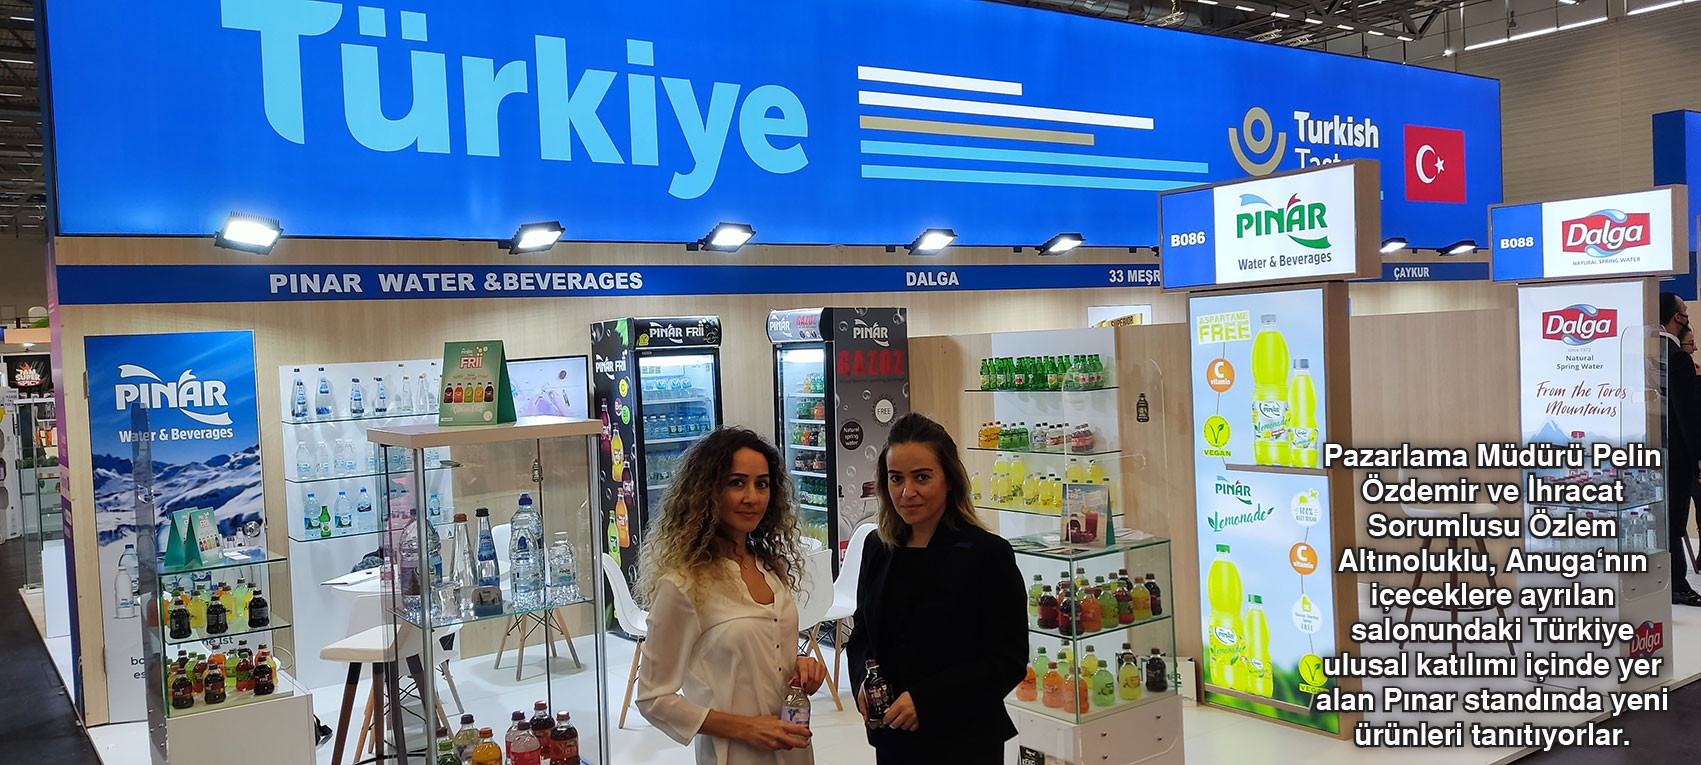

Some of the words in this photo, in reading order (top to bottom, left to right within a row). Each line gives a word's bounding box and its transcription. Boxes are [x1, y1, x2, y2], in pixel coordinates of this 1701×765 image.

[220, 0, 809, 199] Türkiye
[1293, 110, 1380, 149] Turkish
[1236, 200, 1328, 239] PINAR
[1170, 231, 1206, 248] B086
[1500, 236, 1535, 249] B088
[1565, 219, 1644, 250] Dalga
[1238, 256, 1267, 271] Water
[1269, 256, 1277, 268] &
[1279, 250, 1332, 268] Beverages
[905, 271, 960, 287] DALGA
[1109, 269, 1125, 283] 33
[1393, 266, 1430, 281] ÇAYKUR
[269, 273, 364, 294] PINAR
[378, 272, 476, 293] WATER
[483, 271, 644, 291] &BEVERAGES
[1200, 312, 1248, 325] ASPARTAME
[1545, 312, 1612, 340] Dalga
[649, 326, 683, 338] PINAR
[853, 325, 889, 339] PINAR
[1199, 320, 1251, 342] FREE
[1214, 361, 1225, 378] C
[1556, 363, 1580, 371] Spring
[115, 378, 229, 411] PINAR
[1536, 380, 1566, 398] From
[1571, 380, 1592, 399] the
[1597, 382, 1627, 399] Toros
[877, 407, 891, 415] FREE
[1545, 400, 1617, 418] Mountains
[119, 430, 156, 443] Water
[158, 429, 169, 442] &
[171, 427, 234, 441] Beverages
[844, 433, 859, 441] spring
[1203, 449, 1232, 457] VEGAN
[1215, 482, 1252, 497] PINAR
[1213, 503, 1268, 533] Lemonade
[1296, 545, 1308, 562] C
[1631, 629, 1661, 653] Dalga
[1300, 684, 1328, 693] VEG
